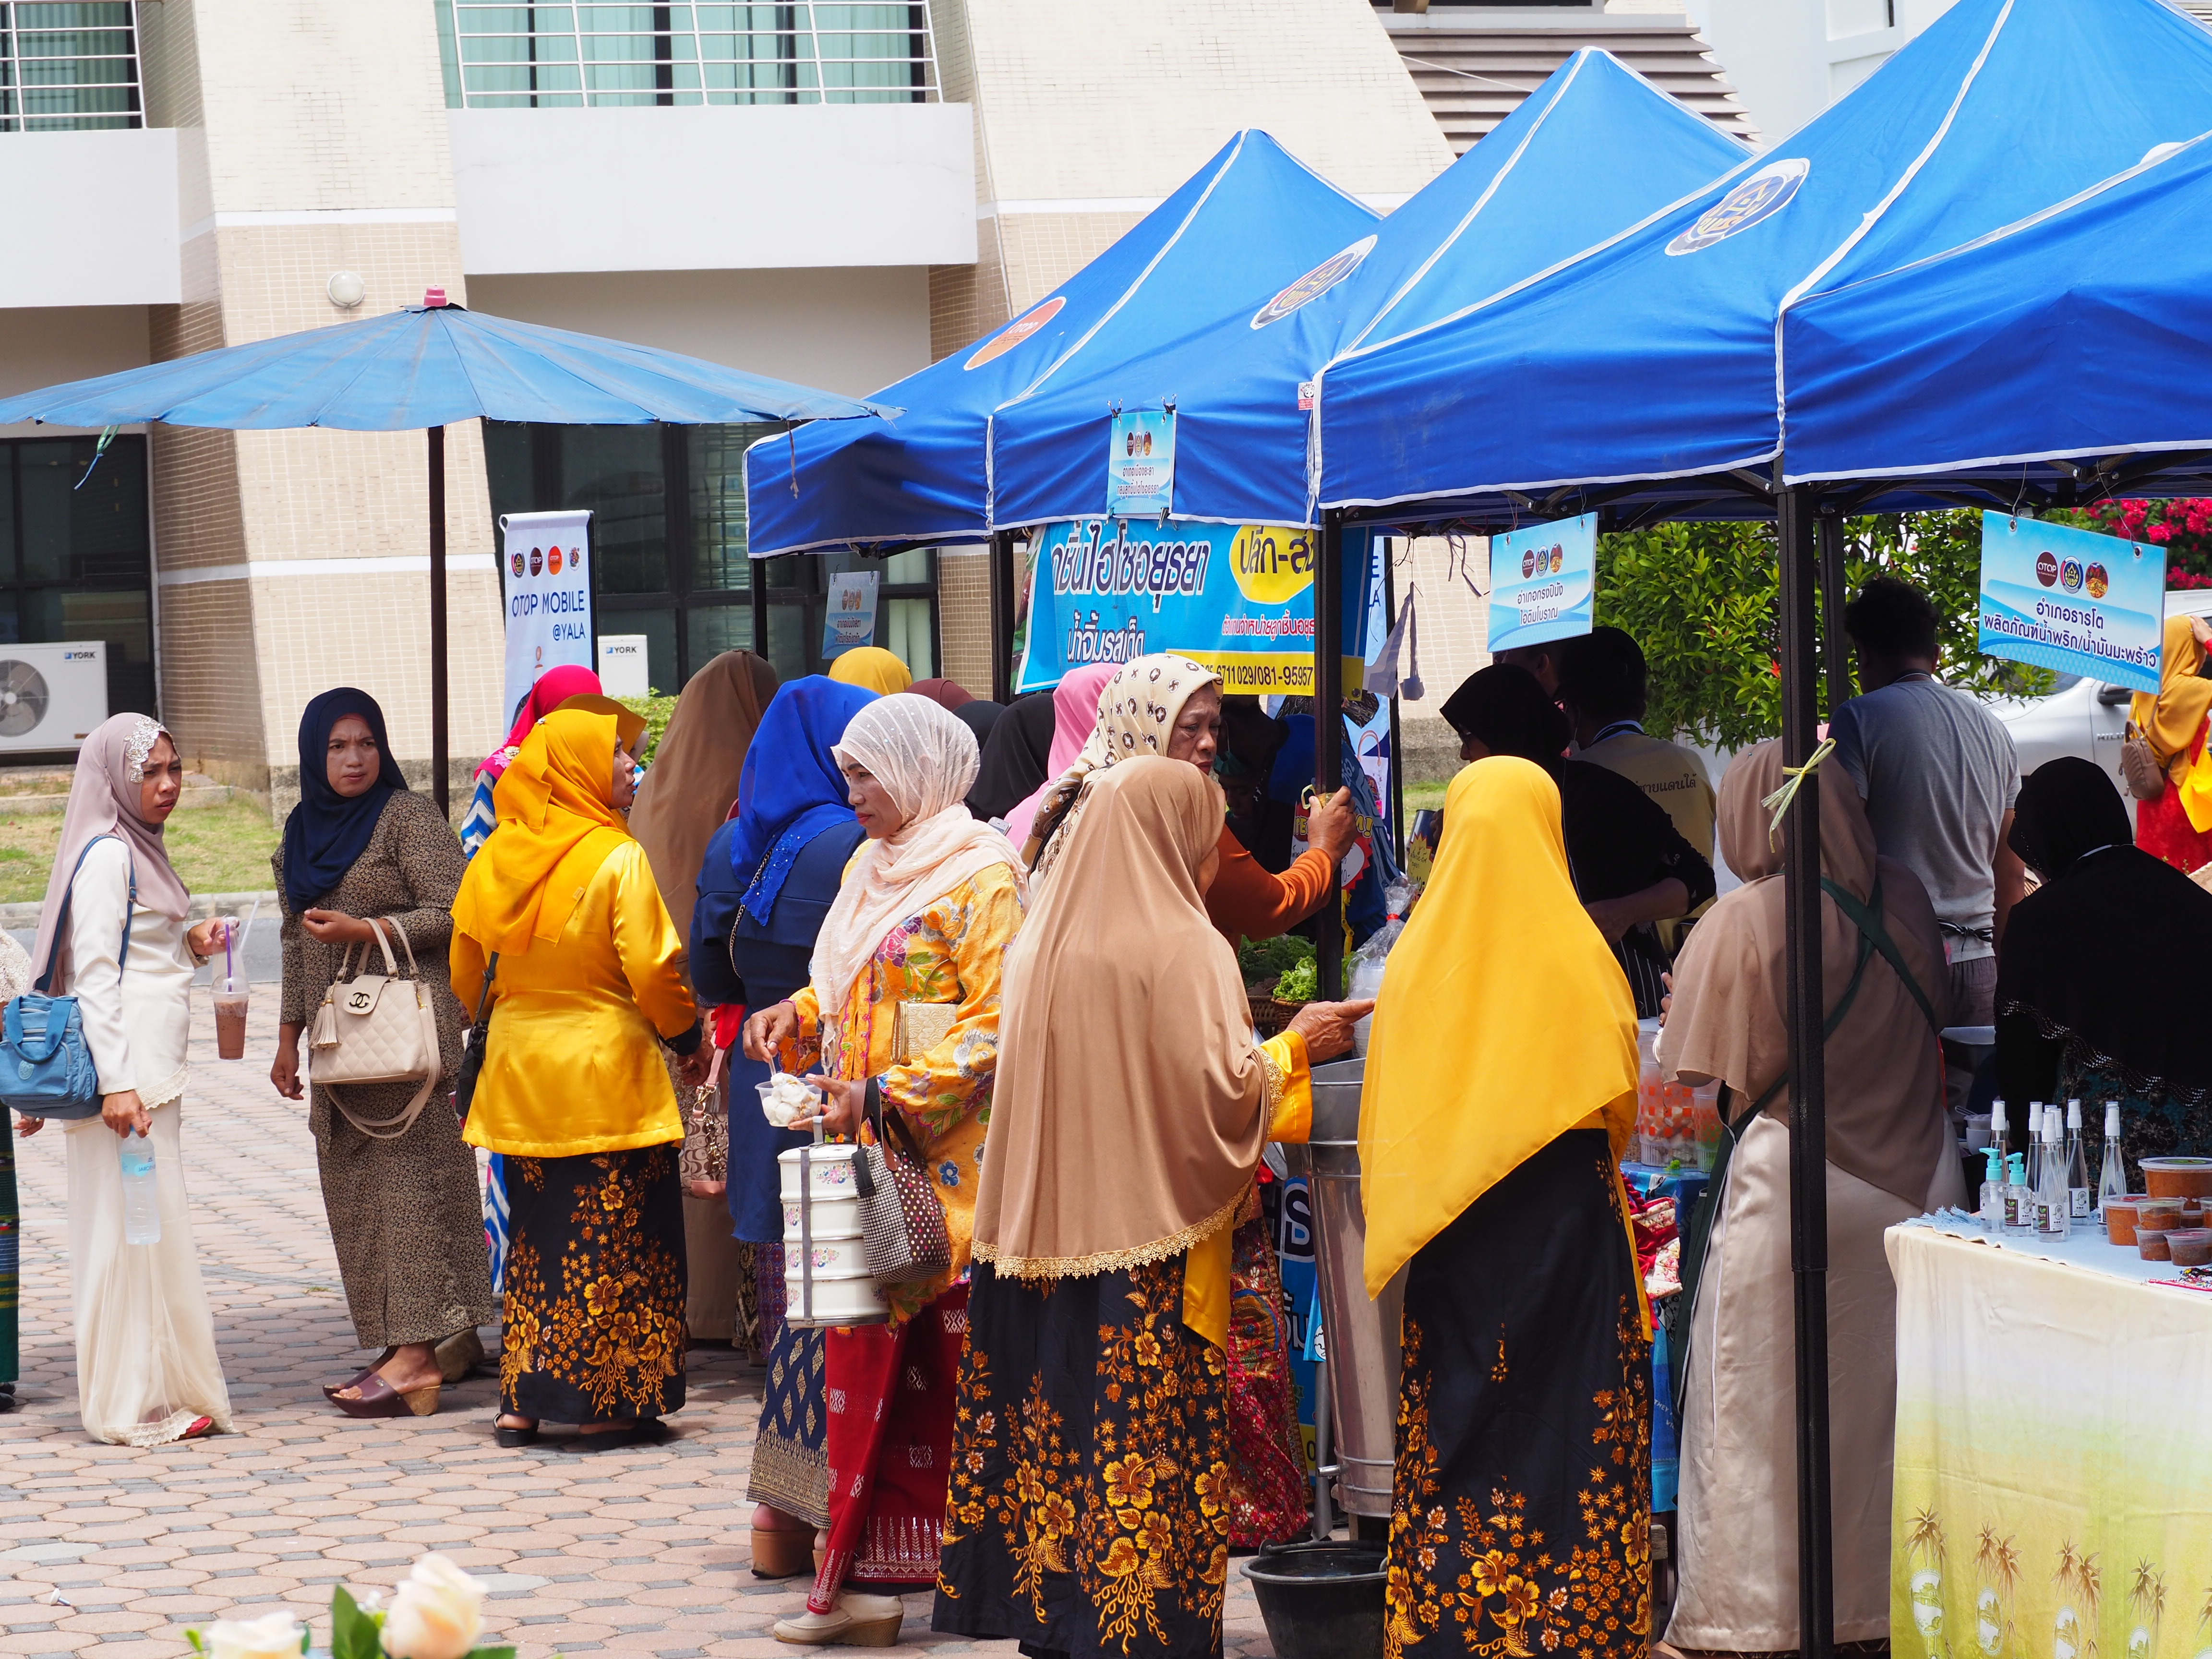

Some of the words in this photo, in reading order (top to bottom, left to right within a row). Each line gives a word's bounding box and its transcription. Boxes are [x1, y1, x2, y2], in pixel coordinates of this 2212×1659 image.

[1523, 558, 1534, 567] OTOP
[2037, 562, 2057, 573] OTOP
[512, 594, 538, 617] OTOP
[542, 590, 585, 614] MOBILE
[1517, 581, 1564, 605] อำเภอกรงปินัง
[2036, 598, 2104, 630] อำเภอธารโต
[553, 622, 586, 641] @YALA
[1983, 614, 2157, 668] ผลิตภัณฑ์น้ำพริก/น้ำมันมะพร้าว
[2096, 732, 2125, 740] HILU
